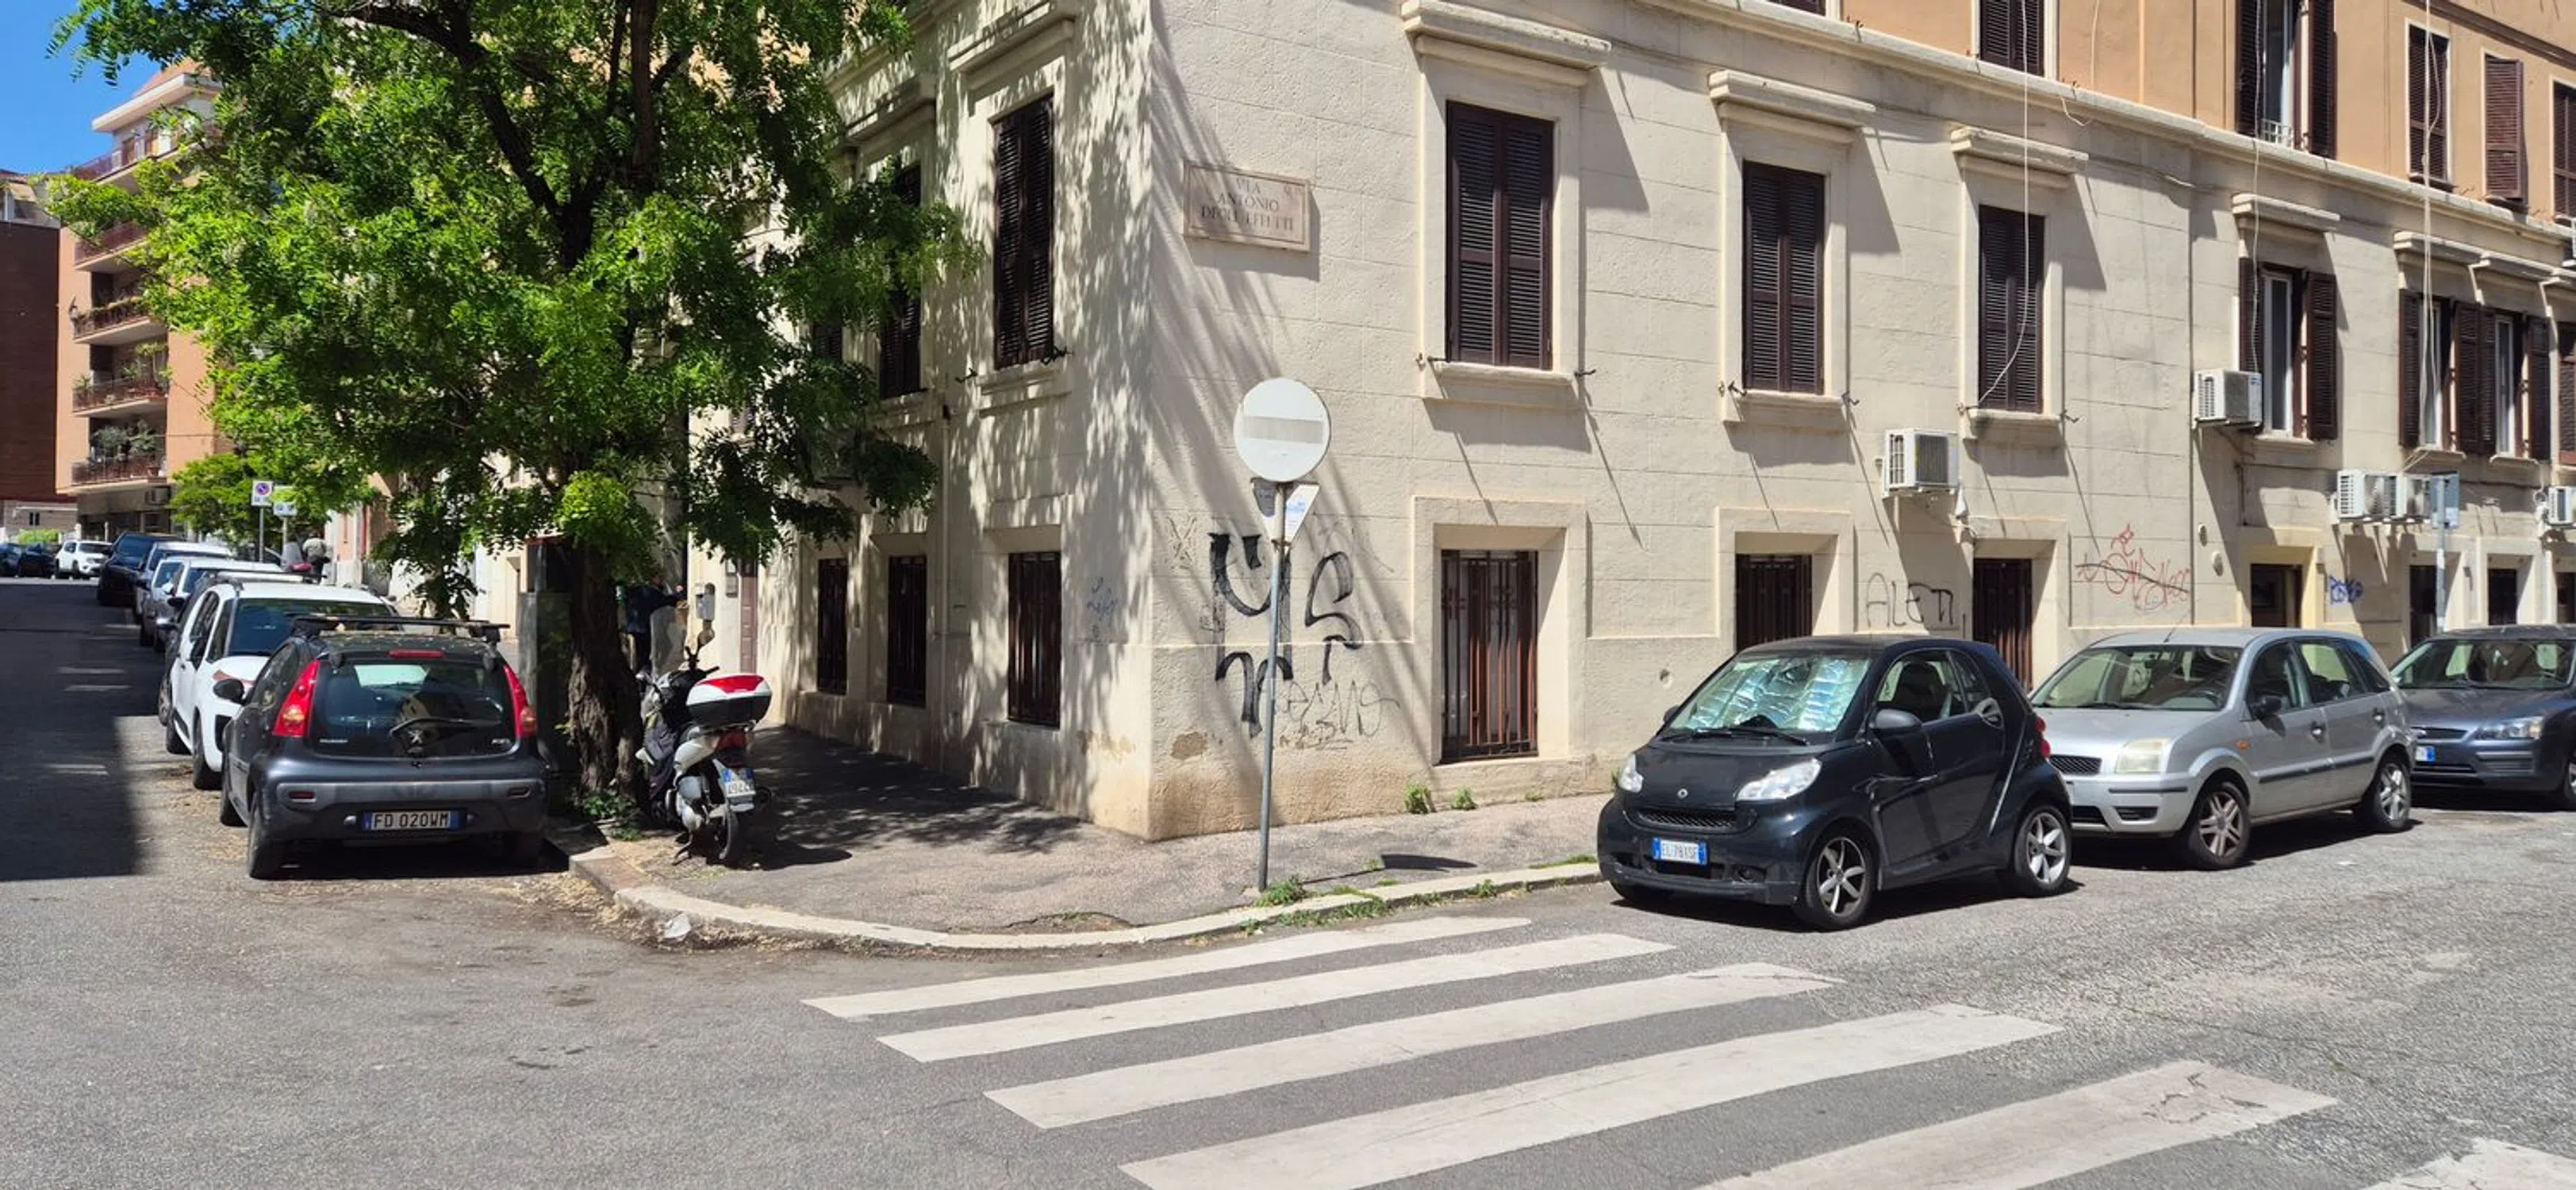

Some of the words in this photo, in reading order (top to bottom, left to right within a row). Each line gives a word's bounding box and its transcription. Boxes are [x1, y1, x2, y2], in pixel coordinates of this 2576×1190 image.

[1236, 178, 1261, 194] VIA
[1217, 192, 1279, 213] ANTONIO
[374, 813, 394, 829] FD
[399, 812, 449, 827] 020WM
